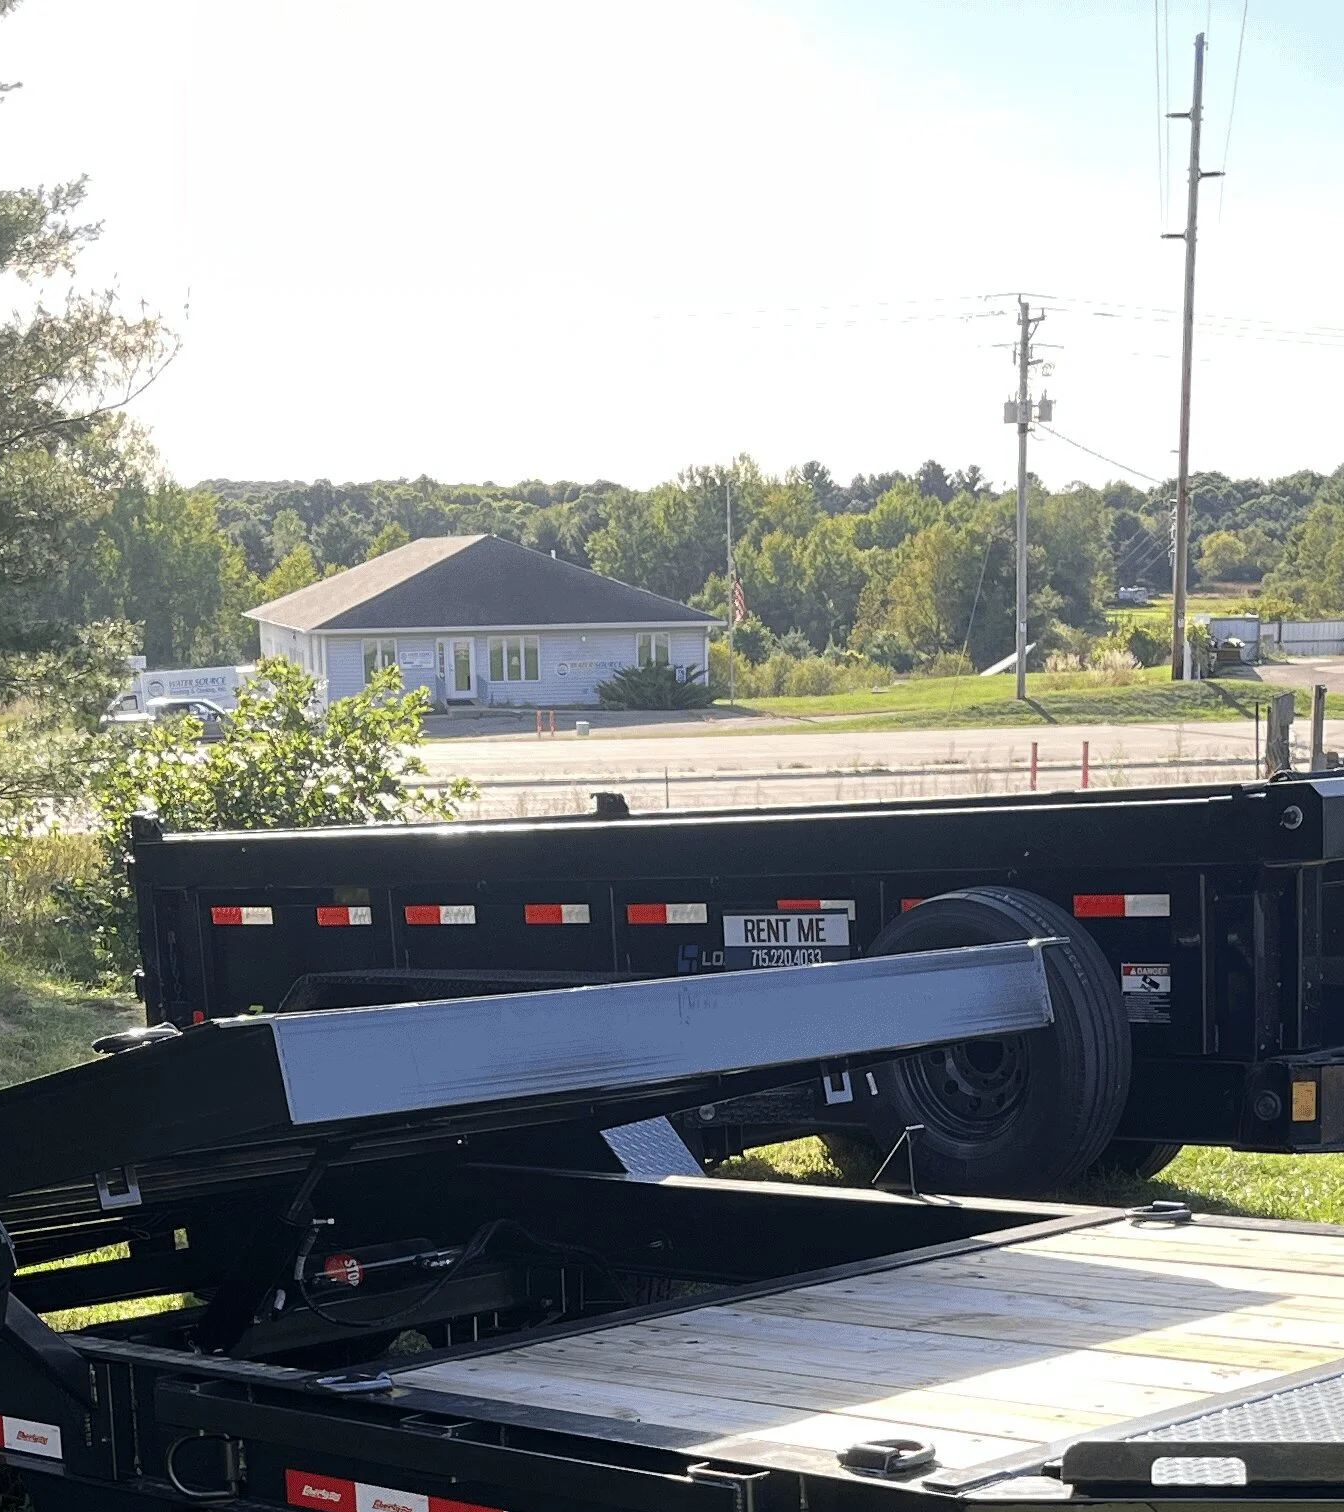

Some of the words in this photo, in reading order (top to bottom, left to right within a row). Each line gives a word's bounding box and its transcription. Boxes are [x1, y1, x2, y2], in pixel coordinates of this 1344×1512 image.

[169, 680, 193, 688] WATER
[195, 677, 226, 687] SOURCE
[743, 918, 791, 943] RENT
[798, 918, 827, 943] ME
[701, 951, 724, 966] LO
[751, 949, 823, 967] 715.220.4033
[344, 1259, 360, 1287] STOP
